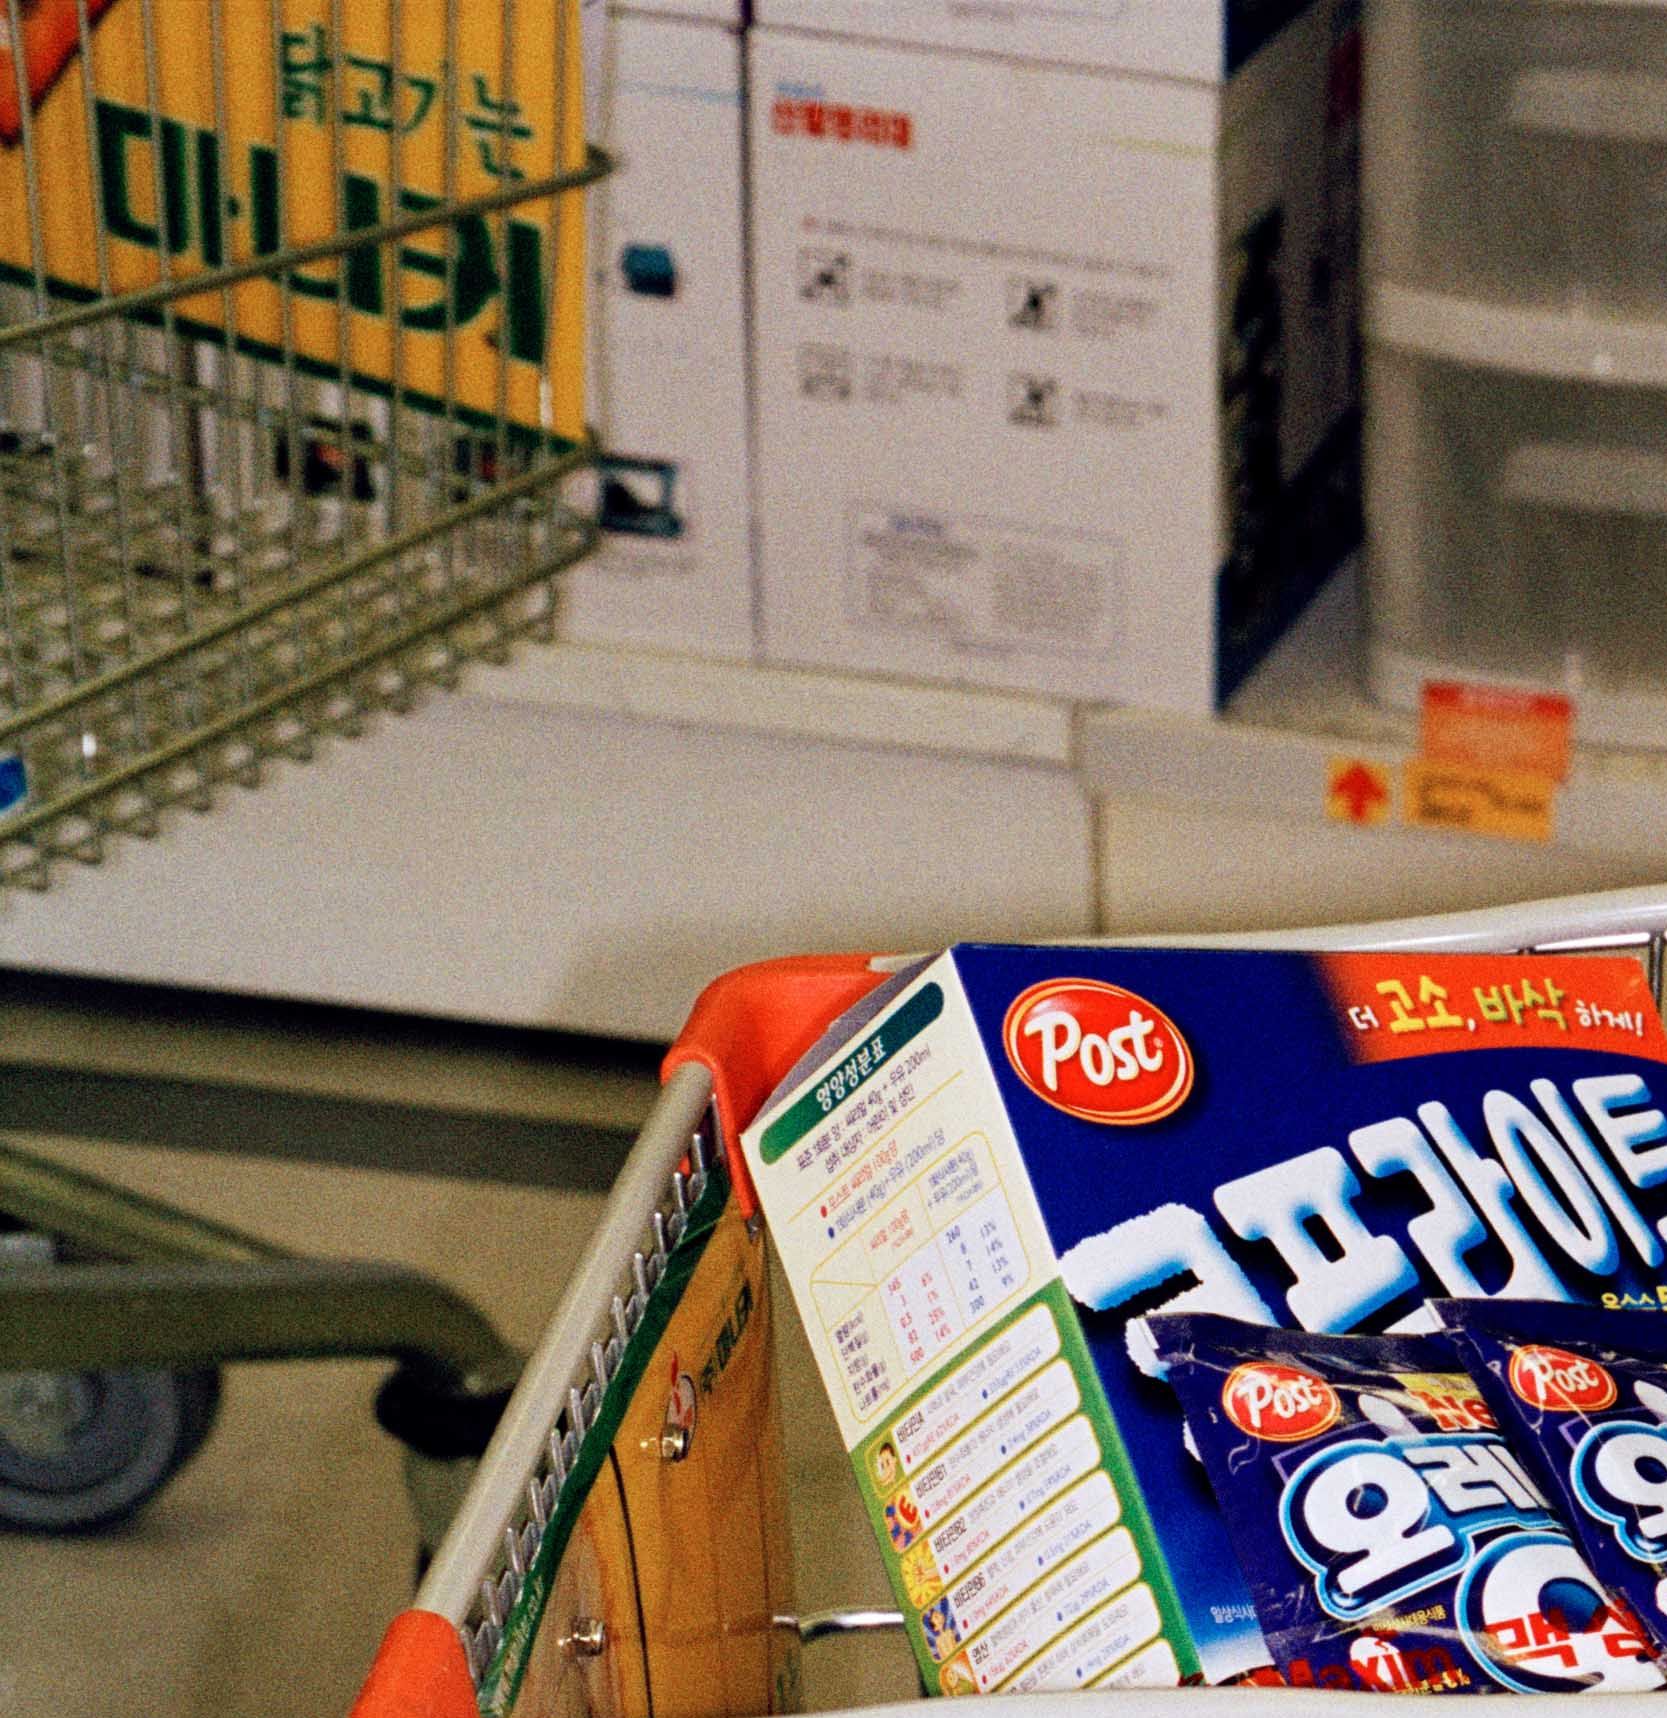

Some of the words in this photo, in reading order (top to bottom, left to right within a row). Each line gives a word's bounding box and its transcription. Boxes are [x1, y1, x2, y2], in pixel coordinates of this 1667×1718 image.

[1348, 1003, 1378, 1034] 더
[1377, 973, 1476, 1034] 고소,
[1476, 976, 1566, 1027] 바삭
[1575, 1001, 1645, 1040] 하게!
[814, 1034, 887, 1115] 영양성분표
[1025, 1010, 1163, 1091] Post
[1236, 1369, 1323, 1429] Post
[1532, 1350, 1604, 1400] Post
[895, 1409, 926, 1445] 비타민A
[913, 1461, 948, 1500] 비타민B1
[933, 1516, 968, 1554] 비타민B2
[1303, 1441, 1550, 1597] 오레
